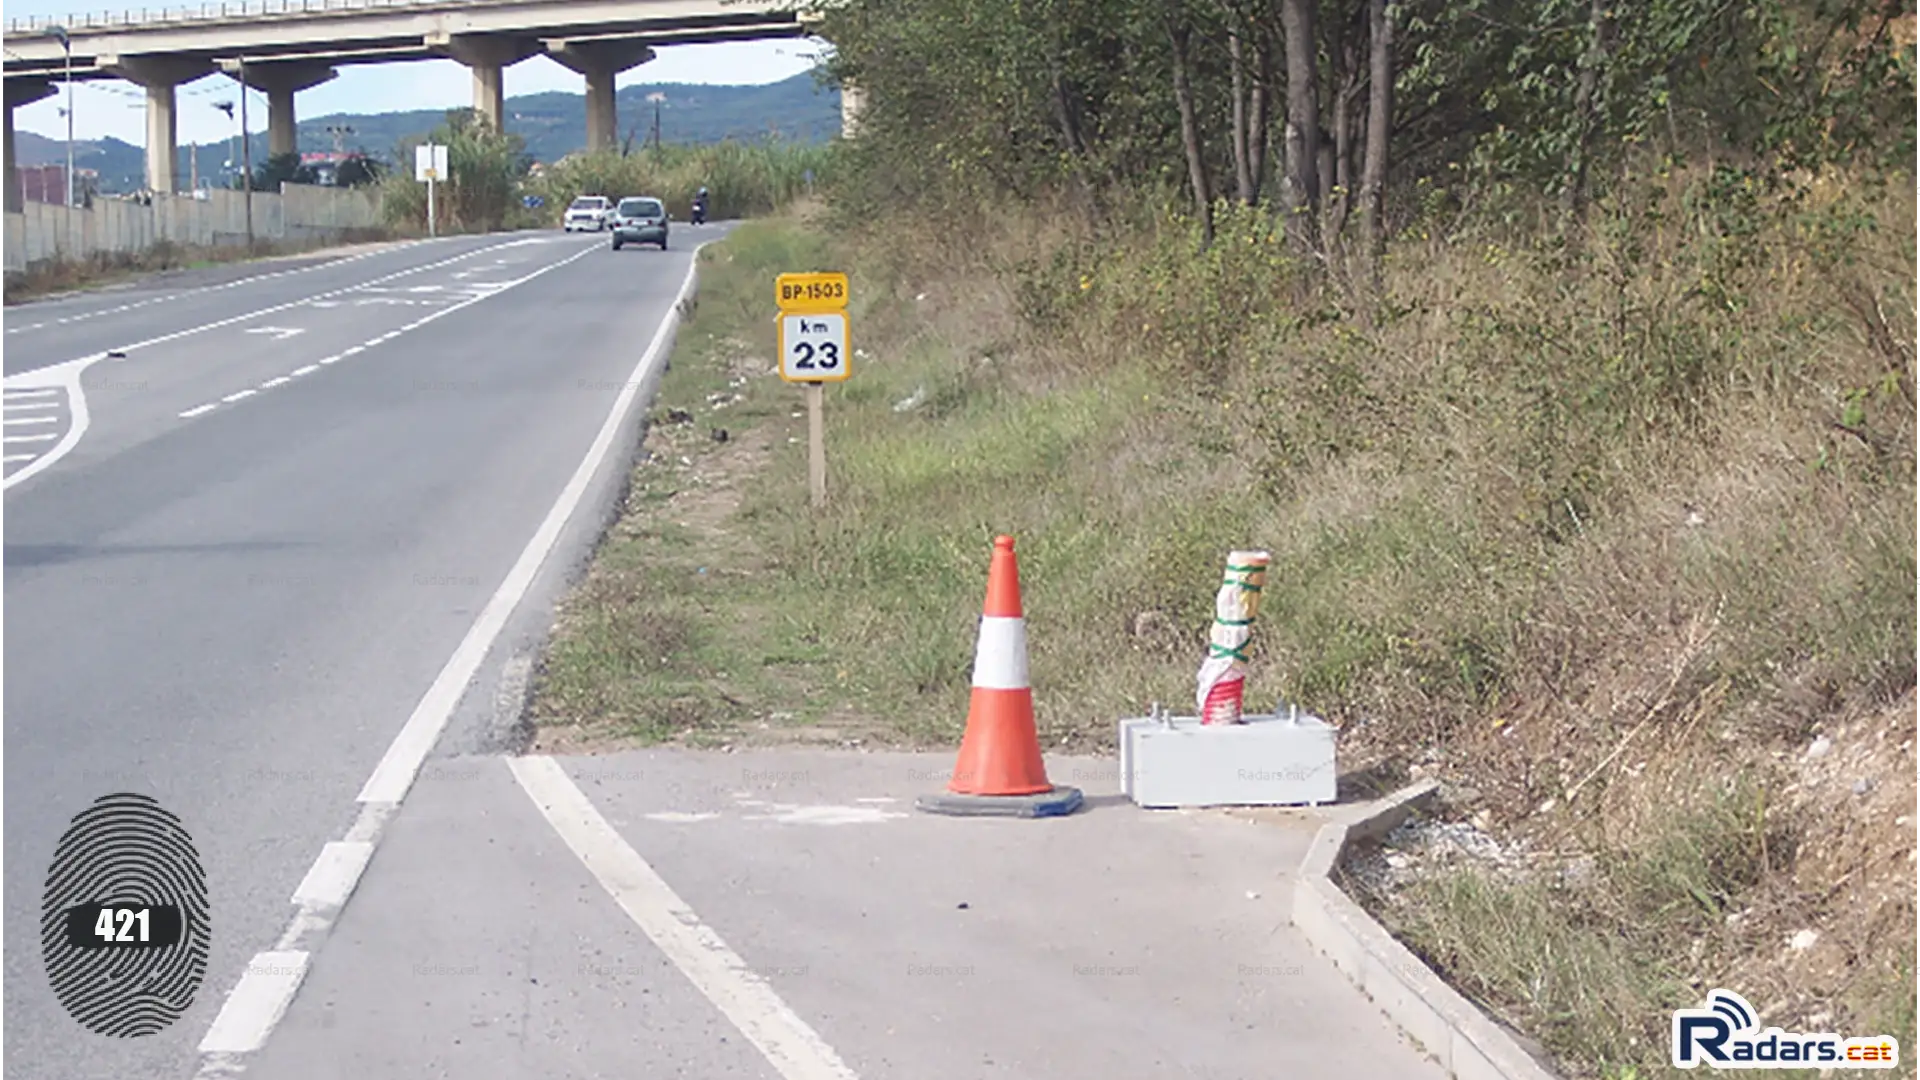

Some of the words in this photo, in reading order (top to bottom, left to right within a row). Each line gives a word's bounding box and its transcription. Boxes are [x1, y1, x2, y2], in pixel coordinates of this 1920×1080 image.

[782, 282, 844, 300] BP-1503
[800, 318, 829, 334] km
[793, 341, 839, 370] 23
